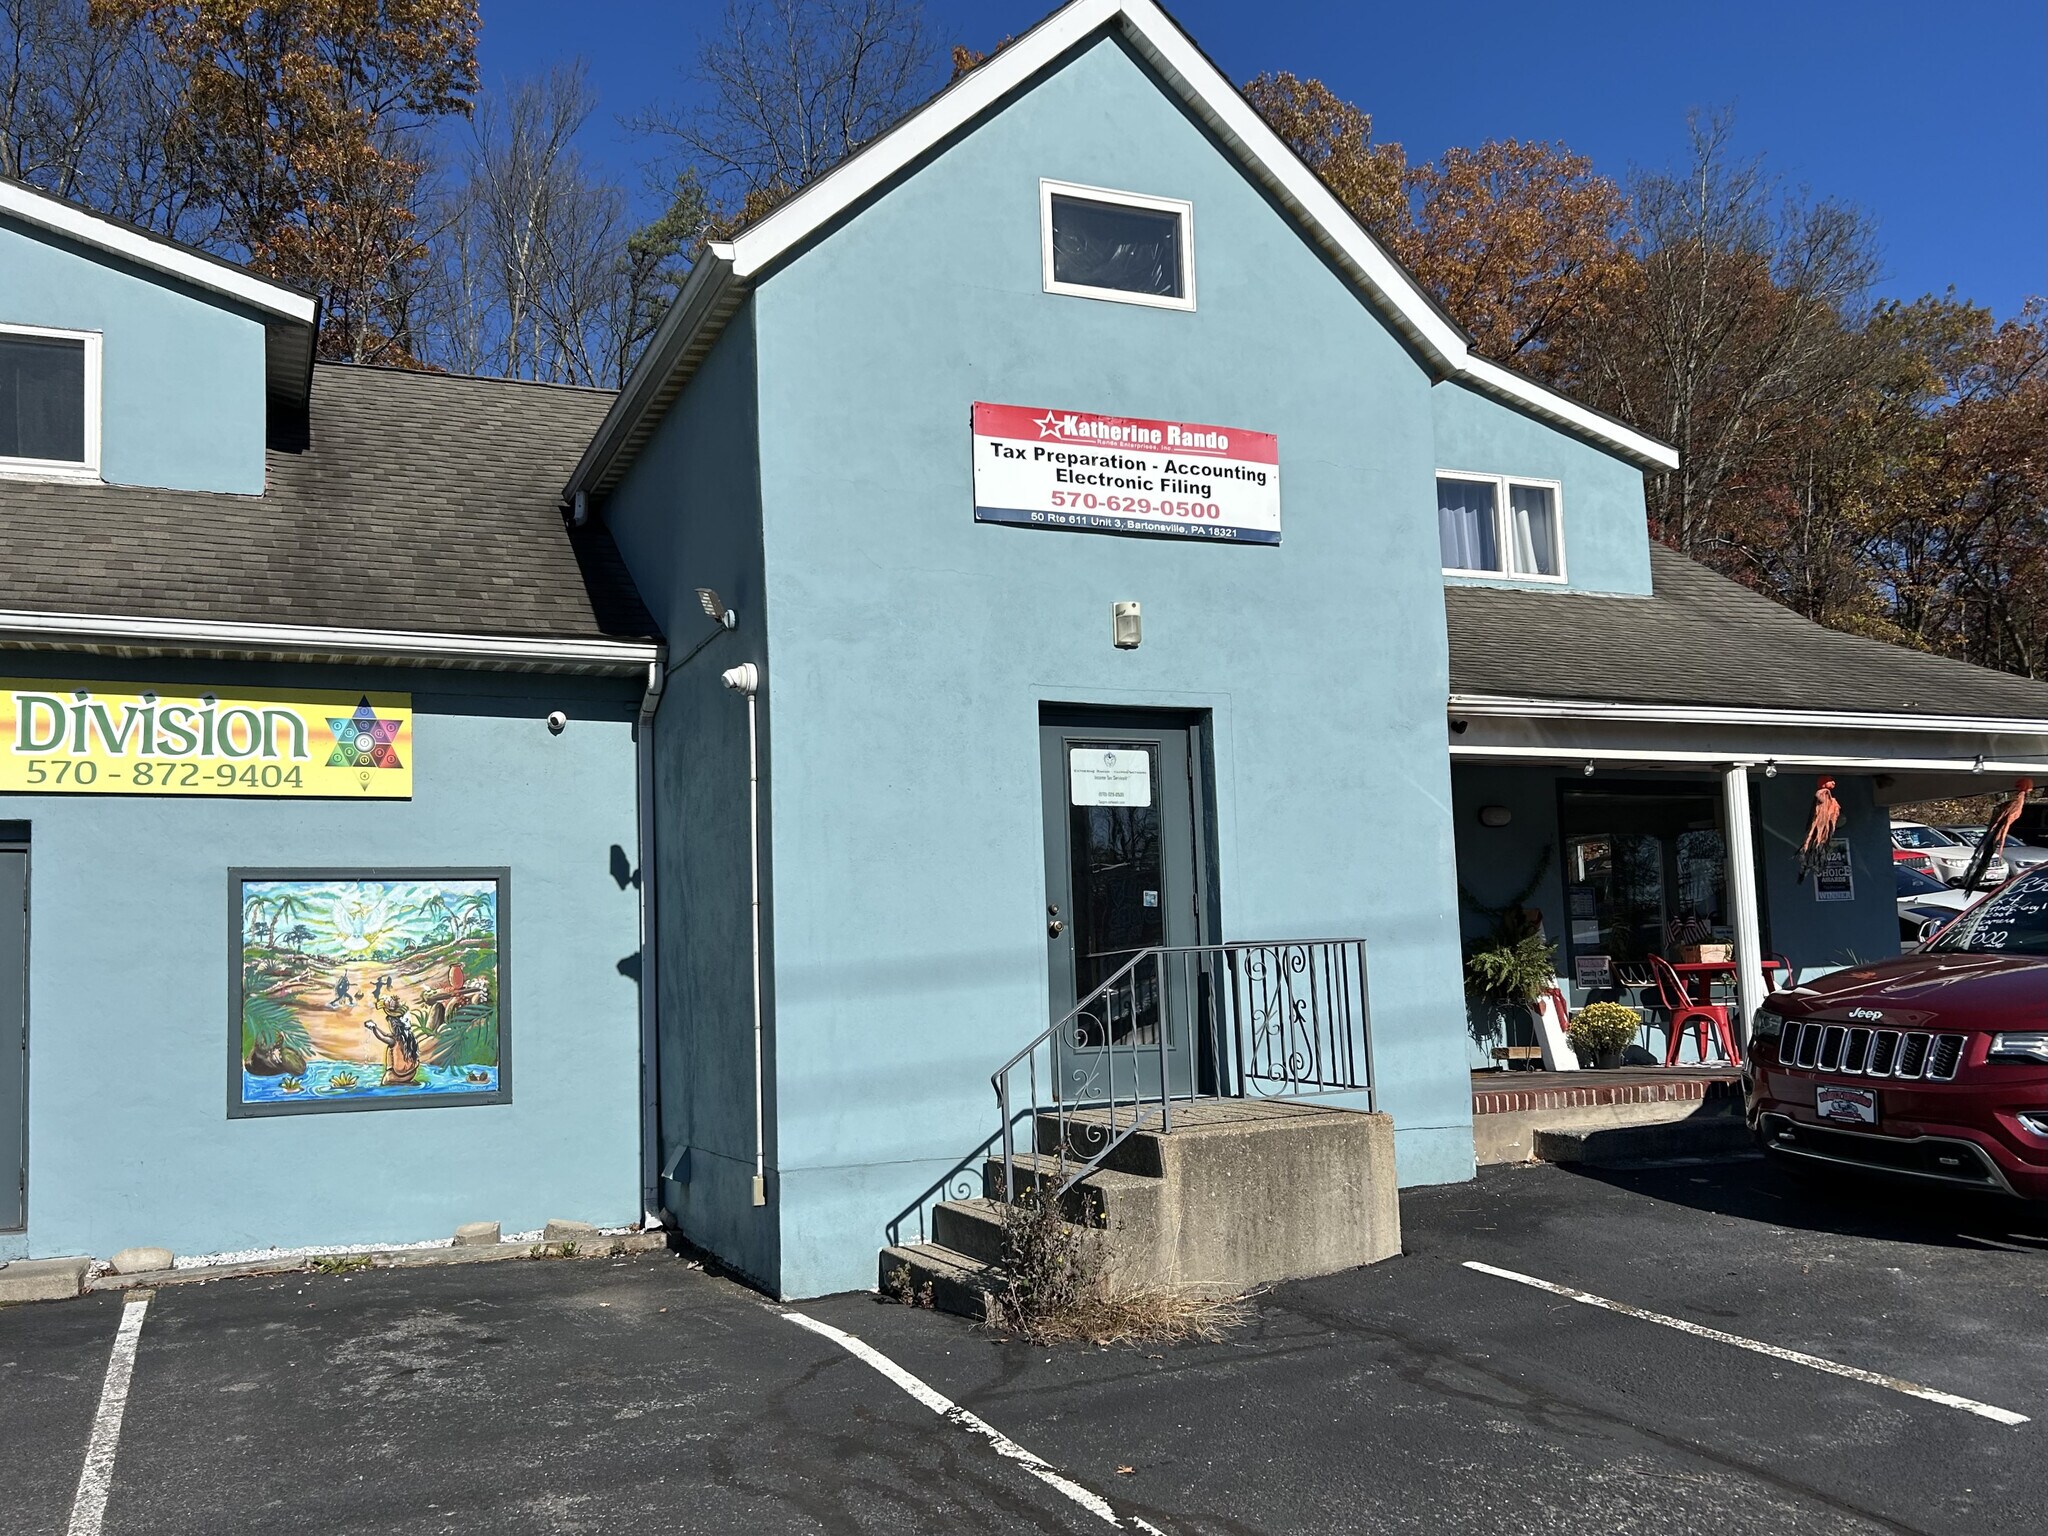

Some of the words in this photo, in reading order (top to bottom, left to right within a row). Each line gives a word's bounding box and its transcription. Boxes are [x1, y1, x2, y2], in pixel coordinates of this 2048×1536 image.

[1063, 414, 1162, 444] Katherine
[1168, 427, 1228, 450] Rando
[990, 442, 1027, 461] Tax
[1034, 447, 1146, 472] Preparation
[1164, 459, 1267, 486] Accounting
[1056, 468, 1154, 491] Electronic
[1160, 479, 1212, 499] Filing
[1051, 490, 1220, 520] 570-629-0500
[1031, 512, 1044, 522] 50
[1048, 514, 1065, 523] Rte
[1069, 515, 1087, 525] 611
[1091, 516, 1112, 527] Unit
[1127, 520, 1188, 534] Bartonsville,
[1191, 526, 1205, 535] PA
[1208, 527, 1238, 538] 18321
[16, 691, 308, 758] Division
[27, 760, 97, 785] 570
[132, 762, 304, 788] 872-9404
[1849, 1007, 1883, 1021] Jeep
